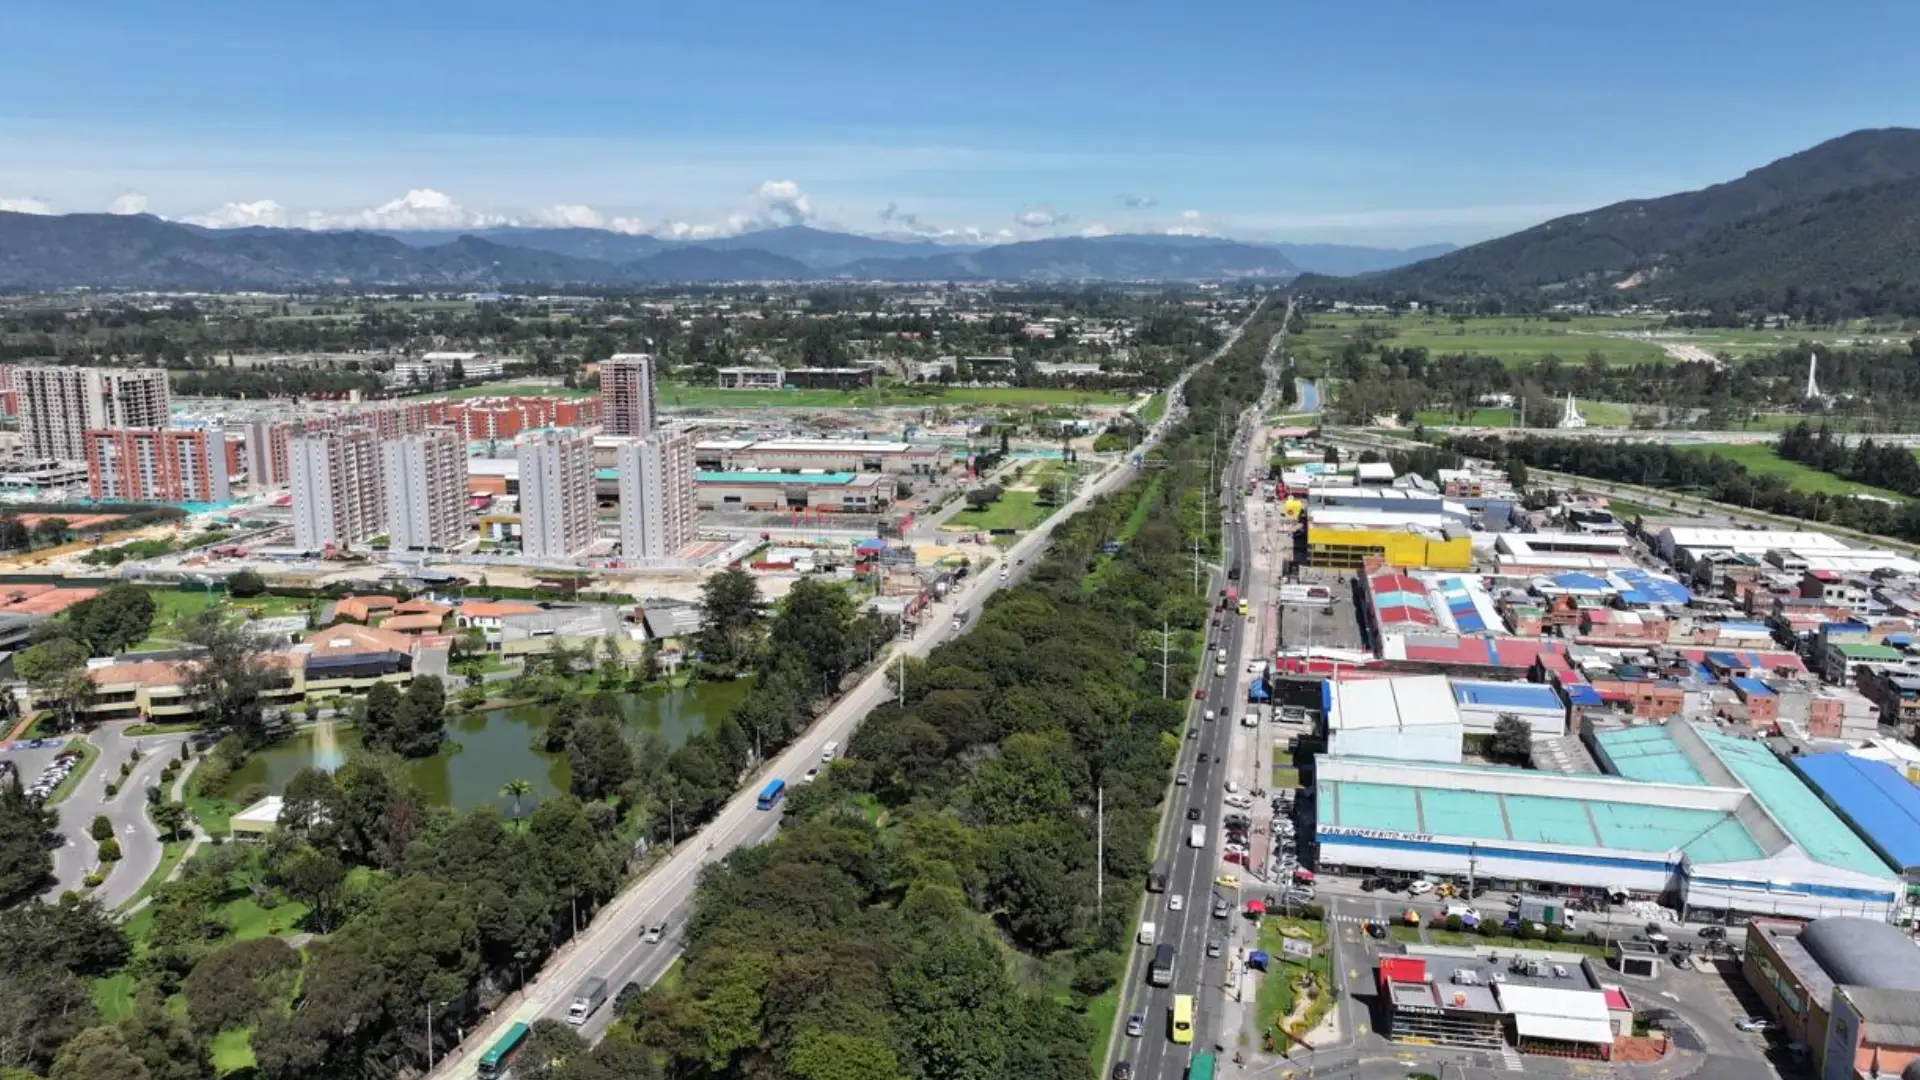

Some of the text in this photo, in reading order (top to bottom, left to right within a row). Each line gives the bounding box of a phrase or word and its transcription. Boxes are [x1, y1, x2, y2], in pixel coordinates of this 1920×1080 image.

[1321, 827, 1340, 835] SAN
[1402, 833, 1434, 842] NORTE
[1397, 1004, 1445, 1015] McDonald's
